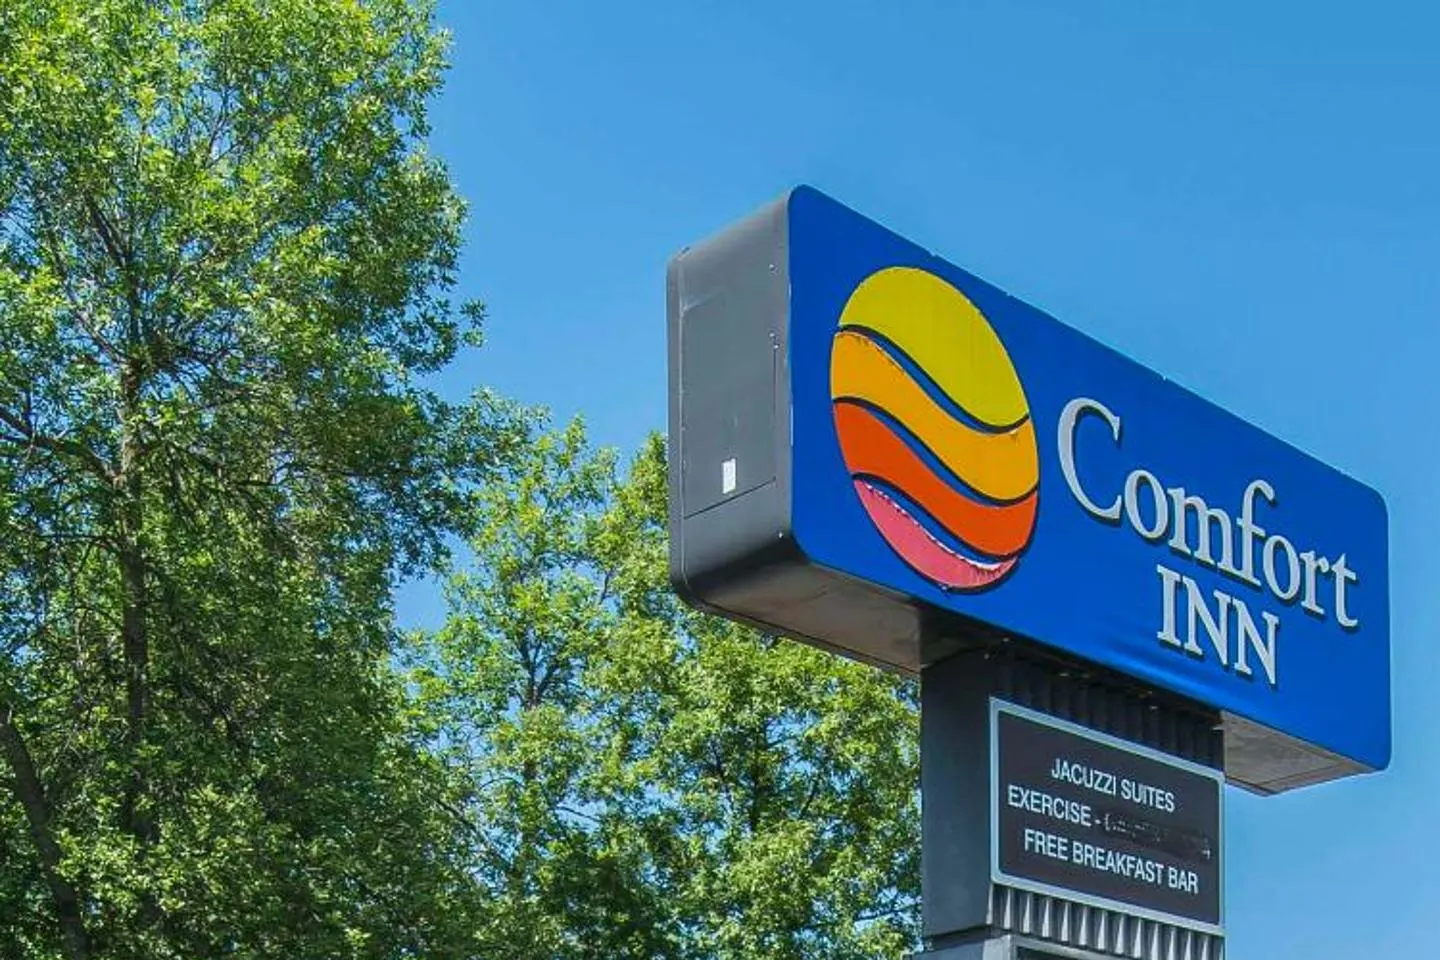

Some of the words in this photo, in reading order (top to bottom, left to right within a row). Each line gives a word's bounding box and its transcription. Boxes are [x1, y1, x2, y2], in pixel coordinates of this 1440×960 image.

[1058, 397, 1358, 627] Comfort
[1157, 564, 1279, 685] INN
[1008, 785, 1092, 827] EXERCISE
[1051, 758, 1117, 797] JACUZZI
[1120, 779, 1175, 813] SUITES
[1024, 829, 1068, 862] FREE
[1072, 840, 1165, 884] BREAKFAST
[1168, 867, 1199, 894] BAR
